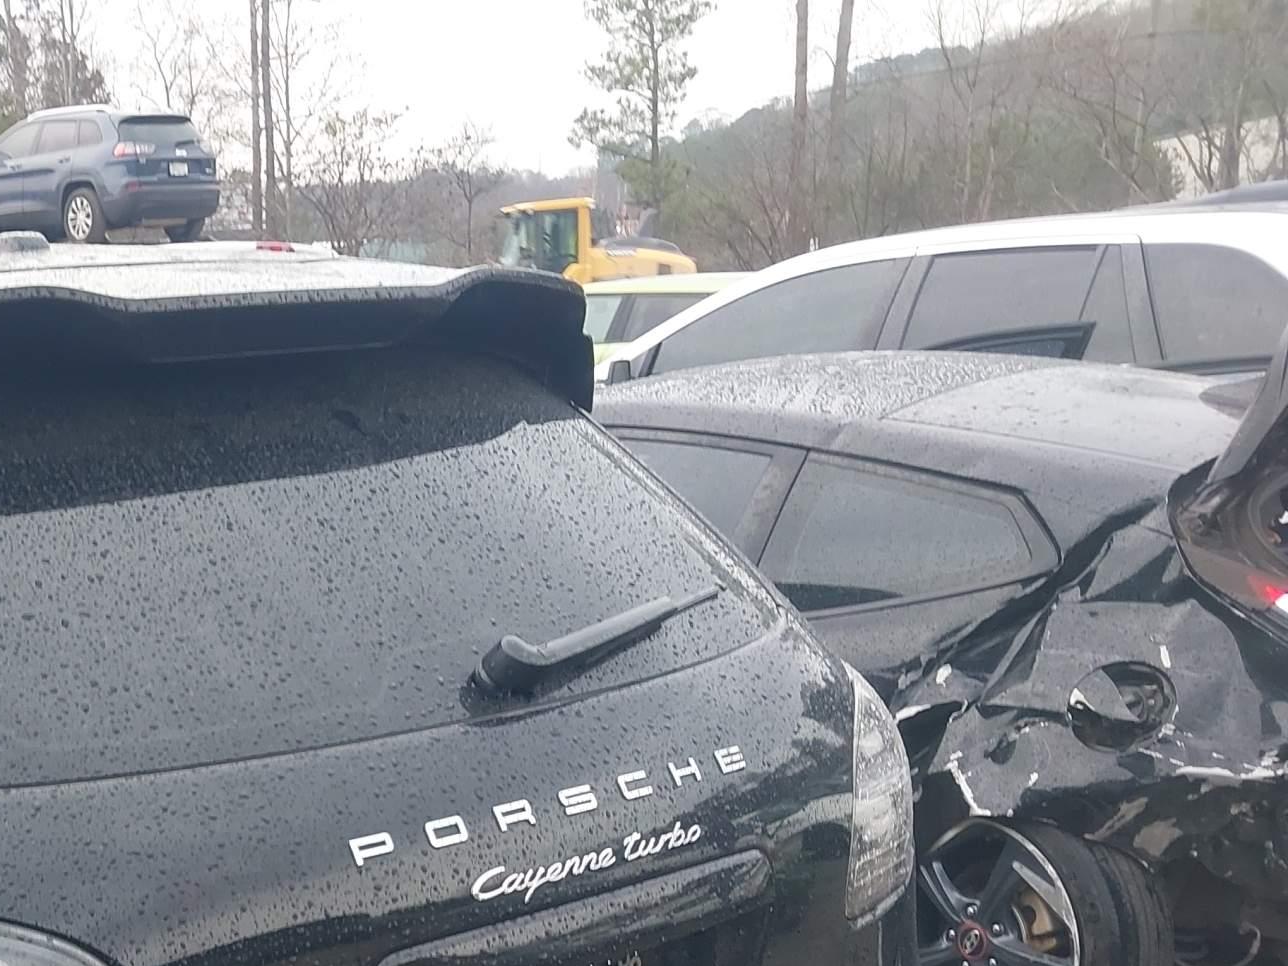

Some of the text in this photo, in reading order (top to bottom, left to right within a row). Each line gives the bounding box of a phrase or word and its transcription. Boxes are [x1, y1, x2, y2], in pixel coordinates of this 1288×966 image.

[348, 745, 747, 866] PORSCHE
[470, 821, 702, 902] Cayenne turbo
